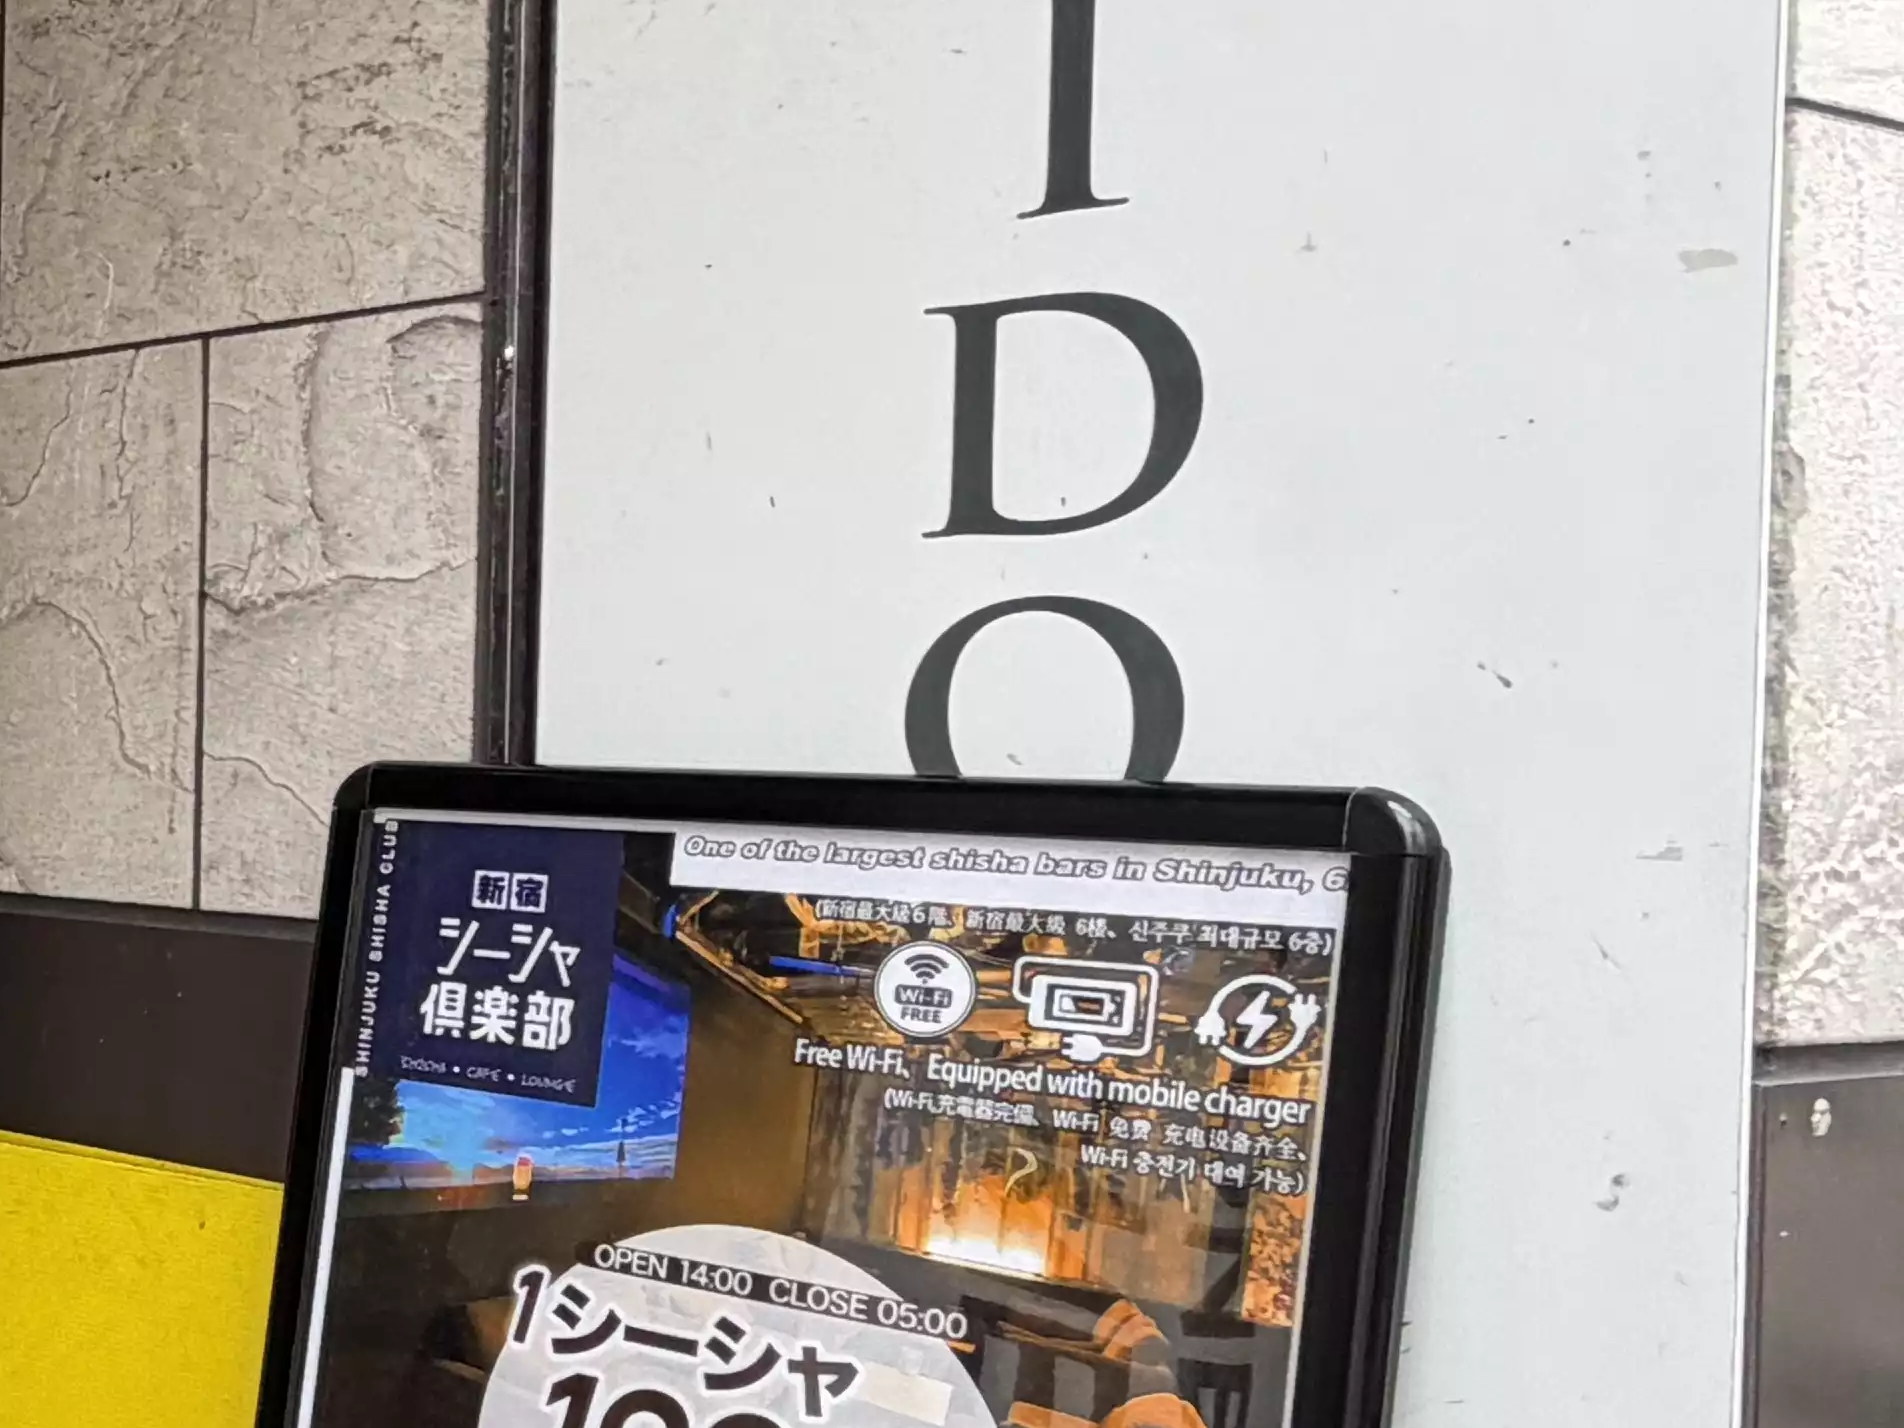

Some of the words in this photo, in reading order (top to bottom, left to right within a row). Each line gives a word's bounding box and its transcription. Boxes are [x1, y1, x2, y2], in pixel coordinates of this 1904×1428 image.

[379, 820, 399, 875] CLUB
[685, 835, 737, 858] One
[742, 838, 774, 859] of
[774, 839, 820, 863] the
[823, 841, 926, 871] largest
[929, 847, 1029, 875] shisha
[1034, 852, 1105, 879] bars
[1111, 856, 1146, 882] in
[1153, 858, 1314, 895] Shinjuku,
[475, 872, 547, 911] 新宿
[368, 883, 392, 962] SHISHA
[437, 917, 582, 987] シーシャ
[355, 970, 381, 1079] SHINJUKU
[419, 981, 575, 1051] 倶楽部
[897, 985, 952, 1007] Wi-Fi
[900, 1005, 942, 1024] FREE
[794, 1038, 843, 1069] Free
[927, 1053, 1042, 1094] Equipped
[1047, 1066, 1102, 1099] with
[1108, 1078, 1201, 1112] mobile
[1205, 1086, 1311, 1128] charger
[1053, 1109, 1100, 1132] Wi-Fi
[1081, 1144, 1129, 1169] Wi-Fi
[593, 1242, 669, 1280] OPEN
[679, 1255, 754, 1297] 14:00
[768, 1280, 869, 1322] CLOSE
[877, 1298, 970, 1340] 05:00
